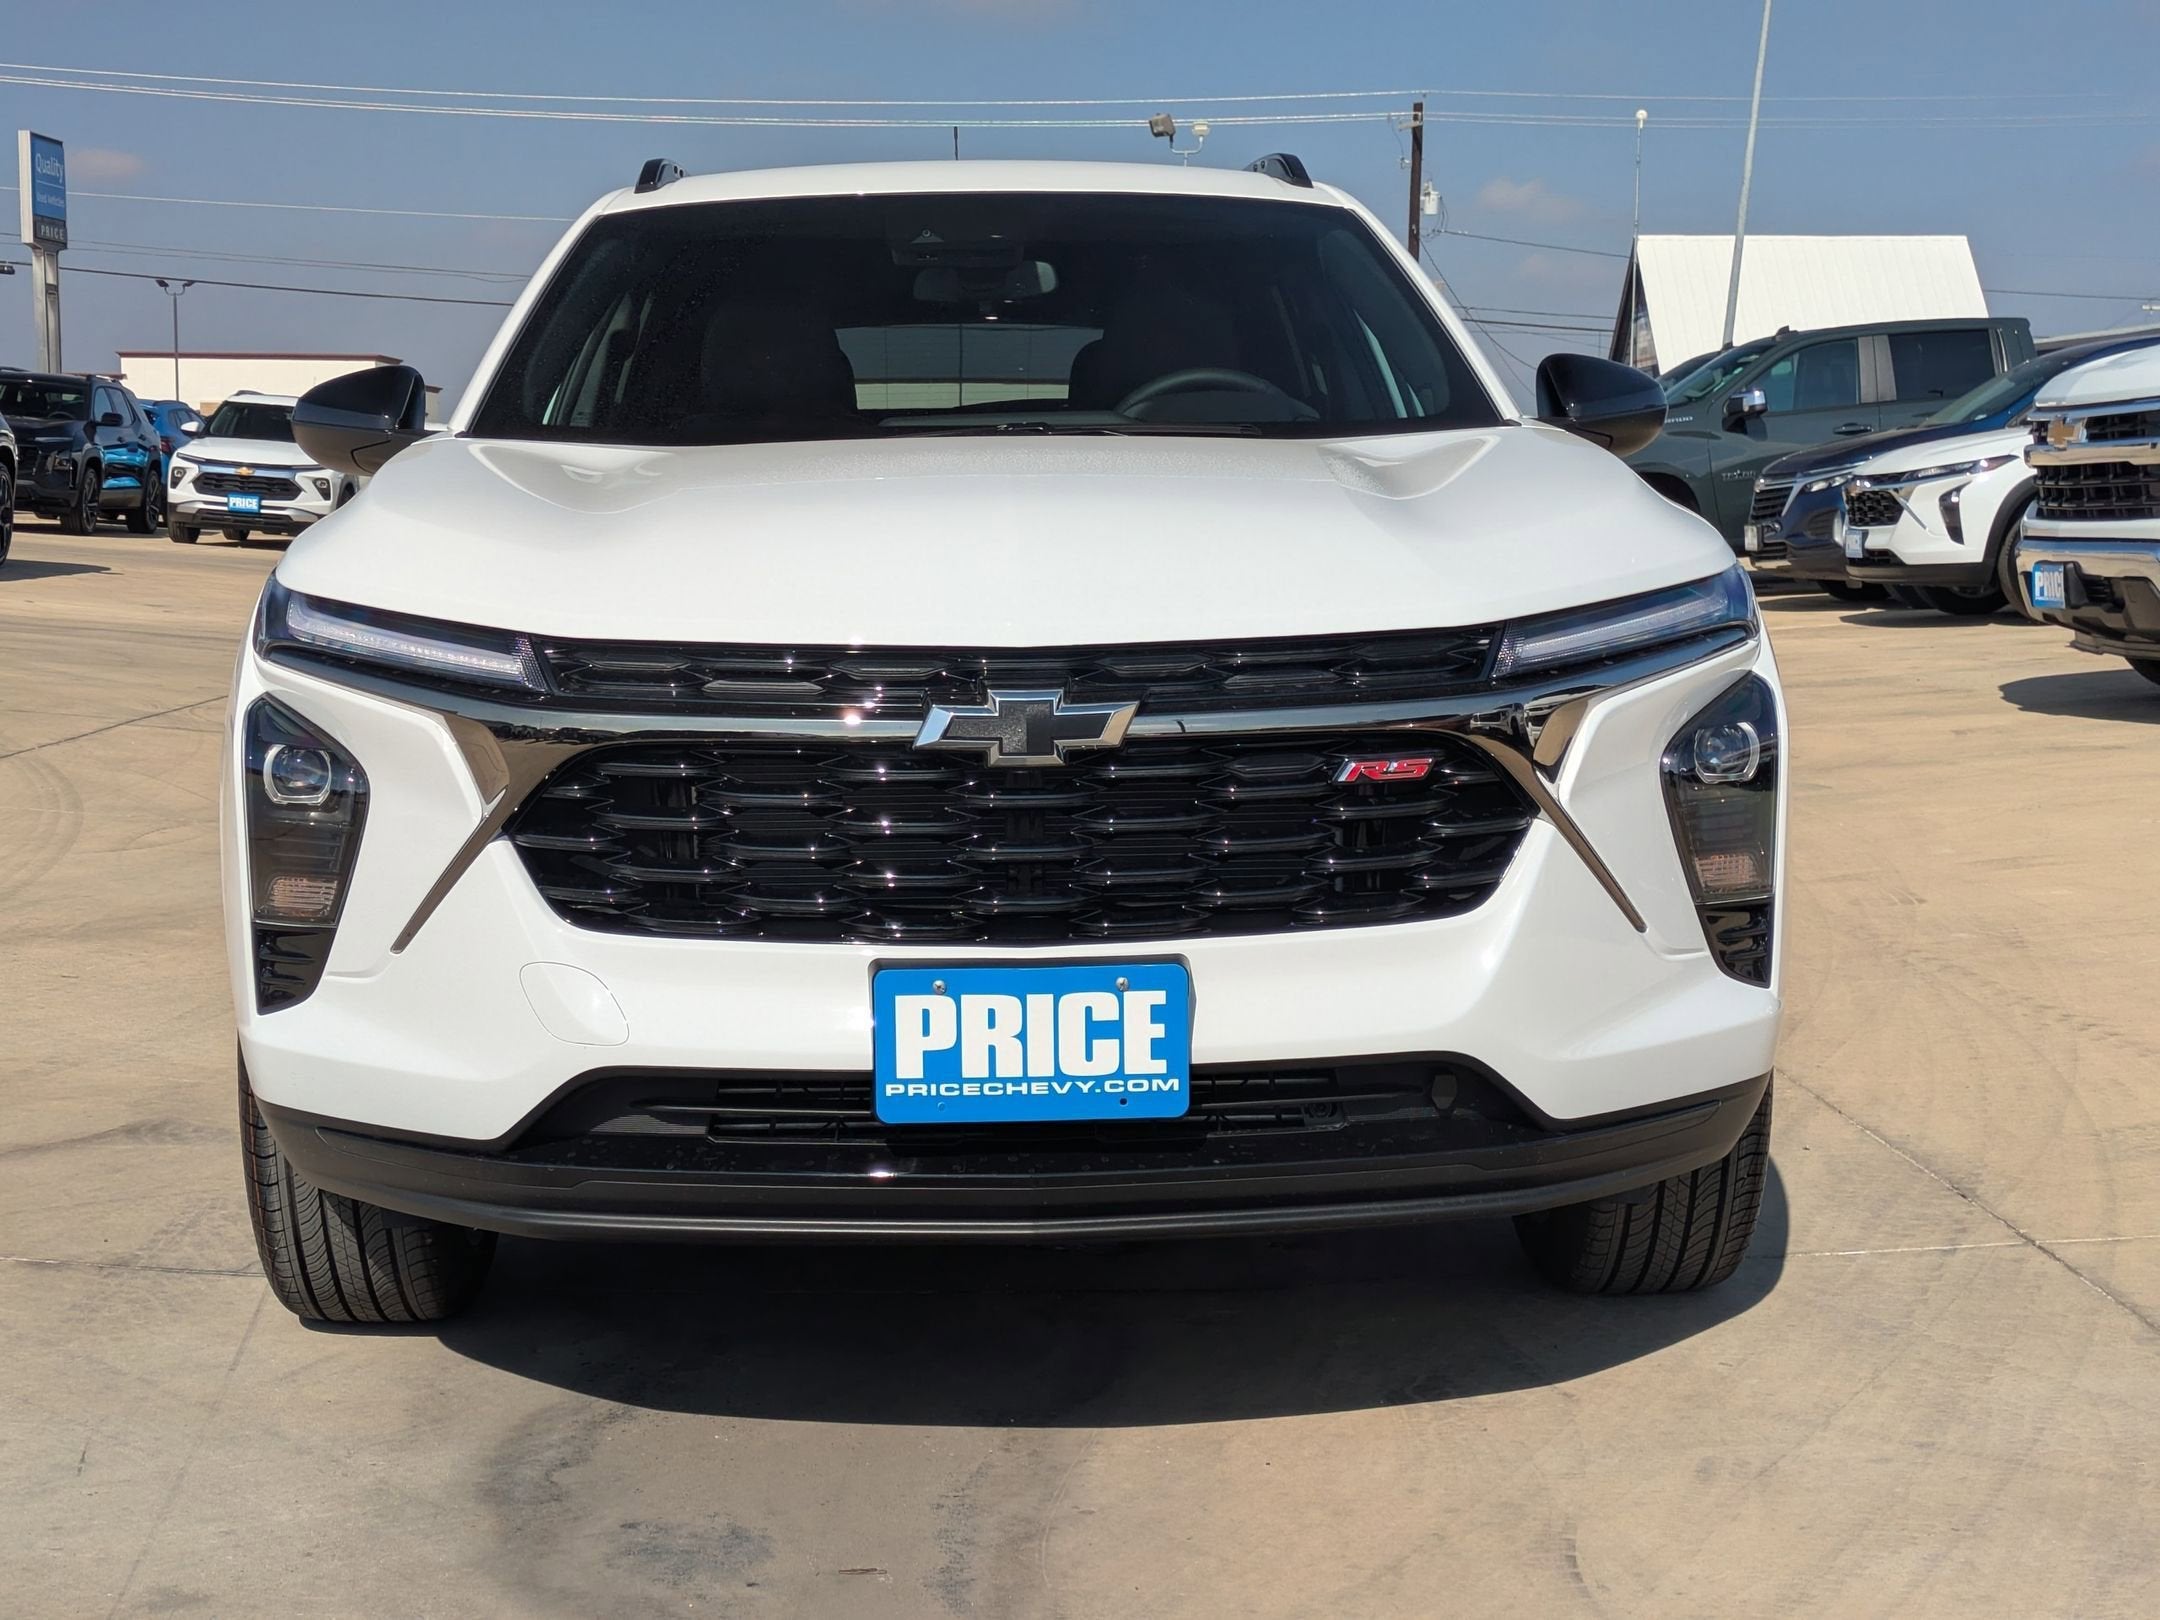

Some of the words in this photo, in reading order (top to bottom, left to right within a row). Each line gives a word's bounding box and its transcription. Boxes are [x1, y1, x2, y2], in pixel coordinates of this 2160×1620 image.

[35, 152, 64, 184] Quality
[41, 224, 65, 240] PRICE
[229, 497, 259, 508] PRICE
[1338, 758, 1432, 781] RS
[895, 990, 1167, 1079] PRICE
[885, 1078, 1180, 1097] PRICECHEVY.COM
